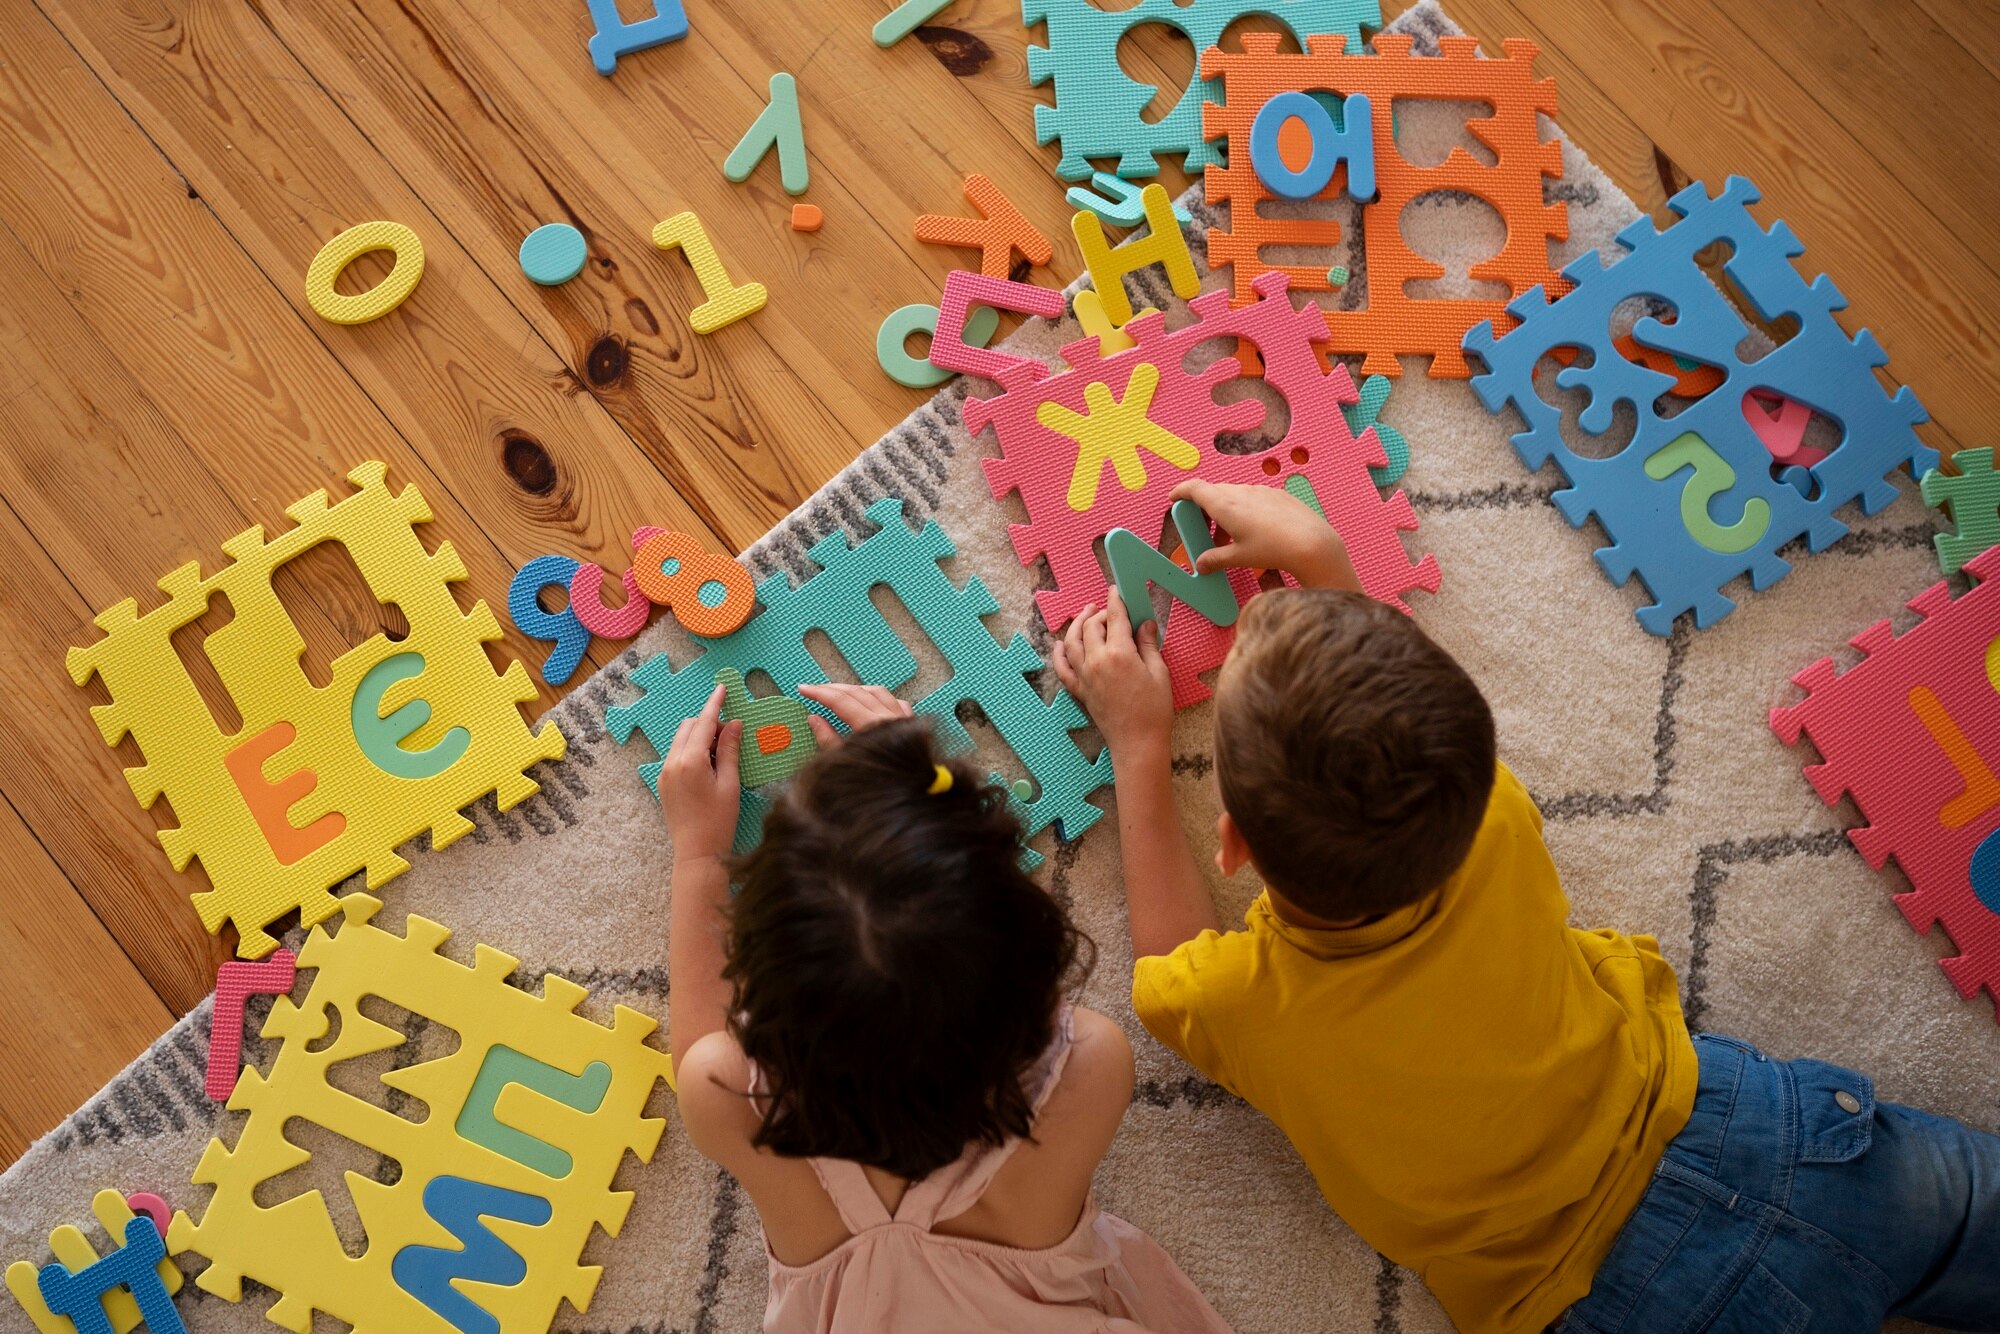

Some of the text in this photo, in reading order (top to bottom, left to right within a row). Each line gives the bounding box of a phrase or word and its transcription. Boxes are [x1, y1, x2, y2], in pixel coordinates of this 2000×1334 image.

[652, 211, 768, 335] 1
[1036, 362, 1200, 512] Ж
[633, 531, 755, 638] 8
